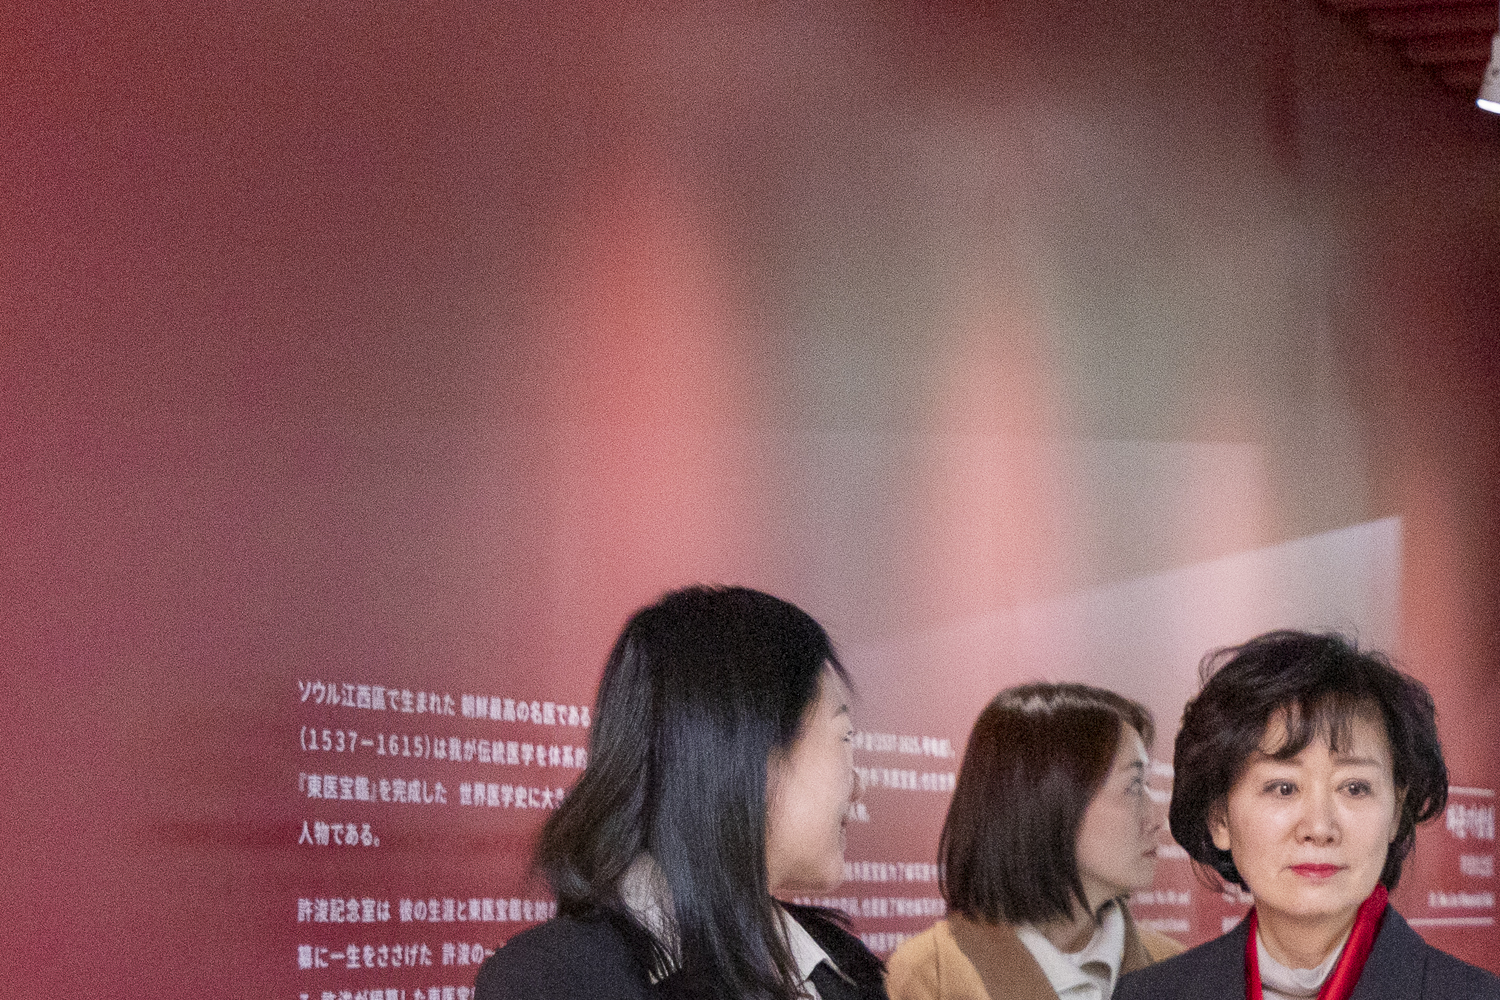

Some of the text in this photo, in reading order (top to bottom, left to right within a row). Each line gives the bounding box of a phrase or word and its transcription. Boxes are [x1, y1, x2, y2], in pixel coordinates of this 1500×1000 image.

[298, 820, 380, 847] 人物である。
[298, 898, 391, 923] 許浚記念室は
